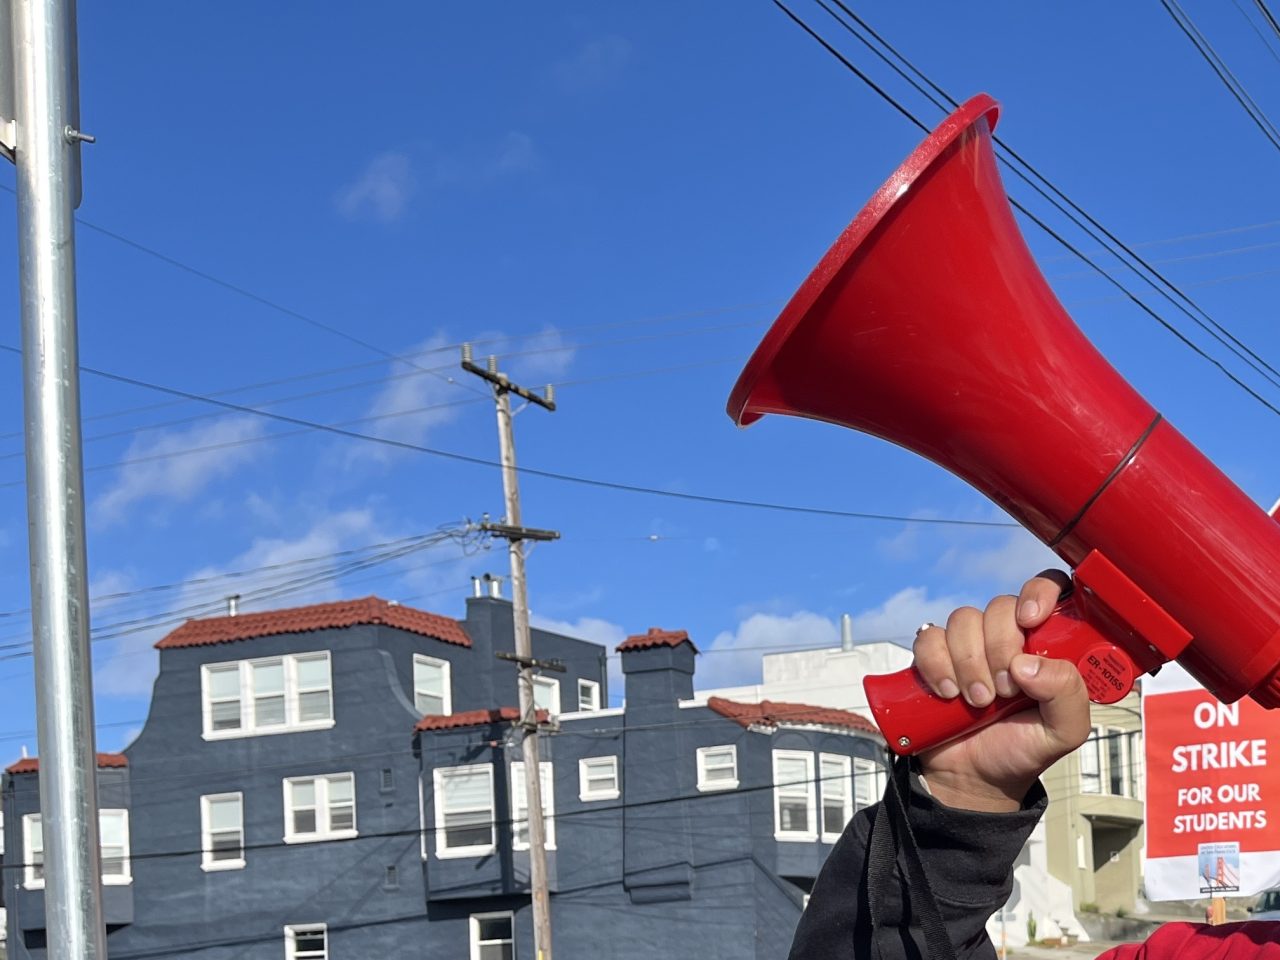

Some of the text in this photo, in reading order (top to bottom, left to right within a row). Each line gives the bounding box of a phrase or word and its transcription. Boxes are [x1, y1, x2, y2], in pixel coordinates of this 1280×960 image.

[1087, 655, 1125, 691] ER-1015S
[1194, 701, 1240, 729] ON
[1171, 739, 1267, 773] STRIKE
[1177, 783, 1262, 807] FOR OUR
[1173, 810, 1267, 833] STUDENTS
